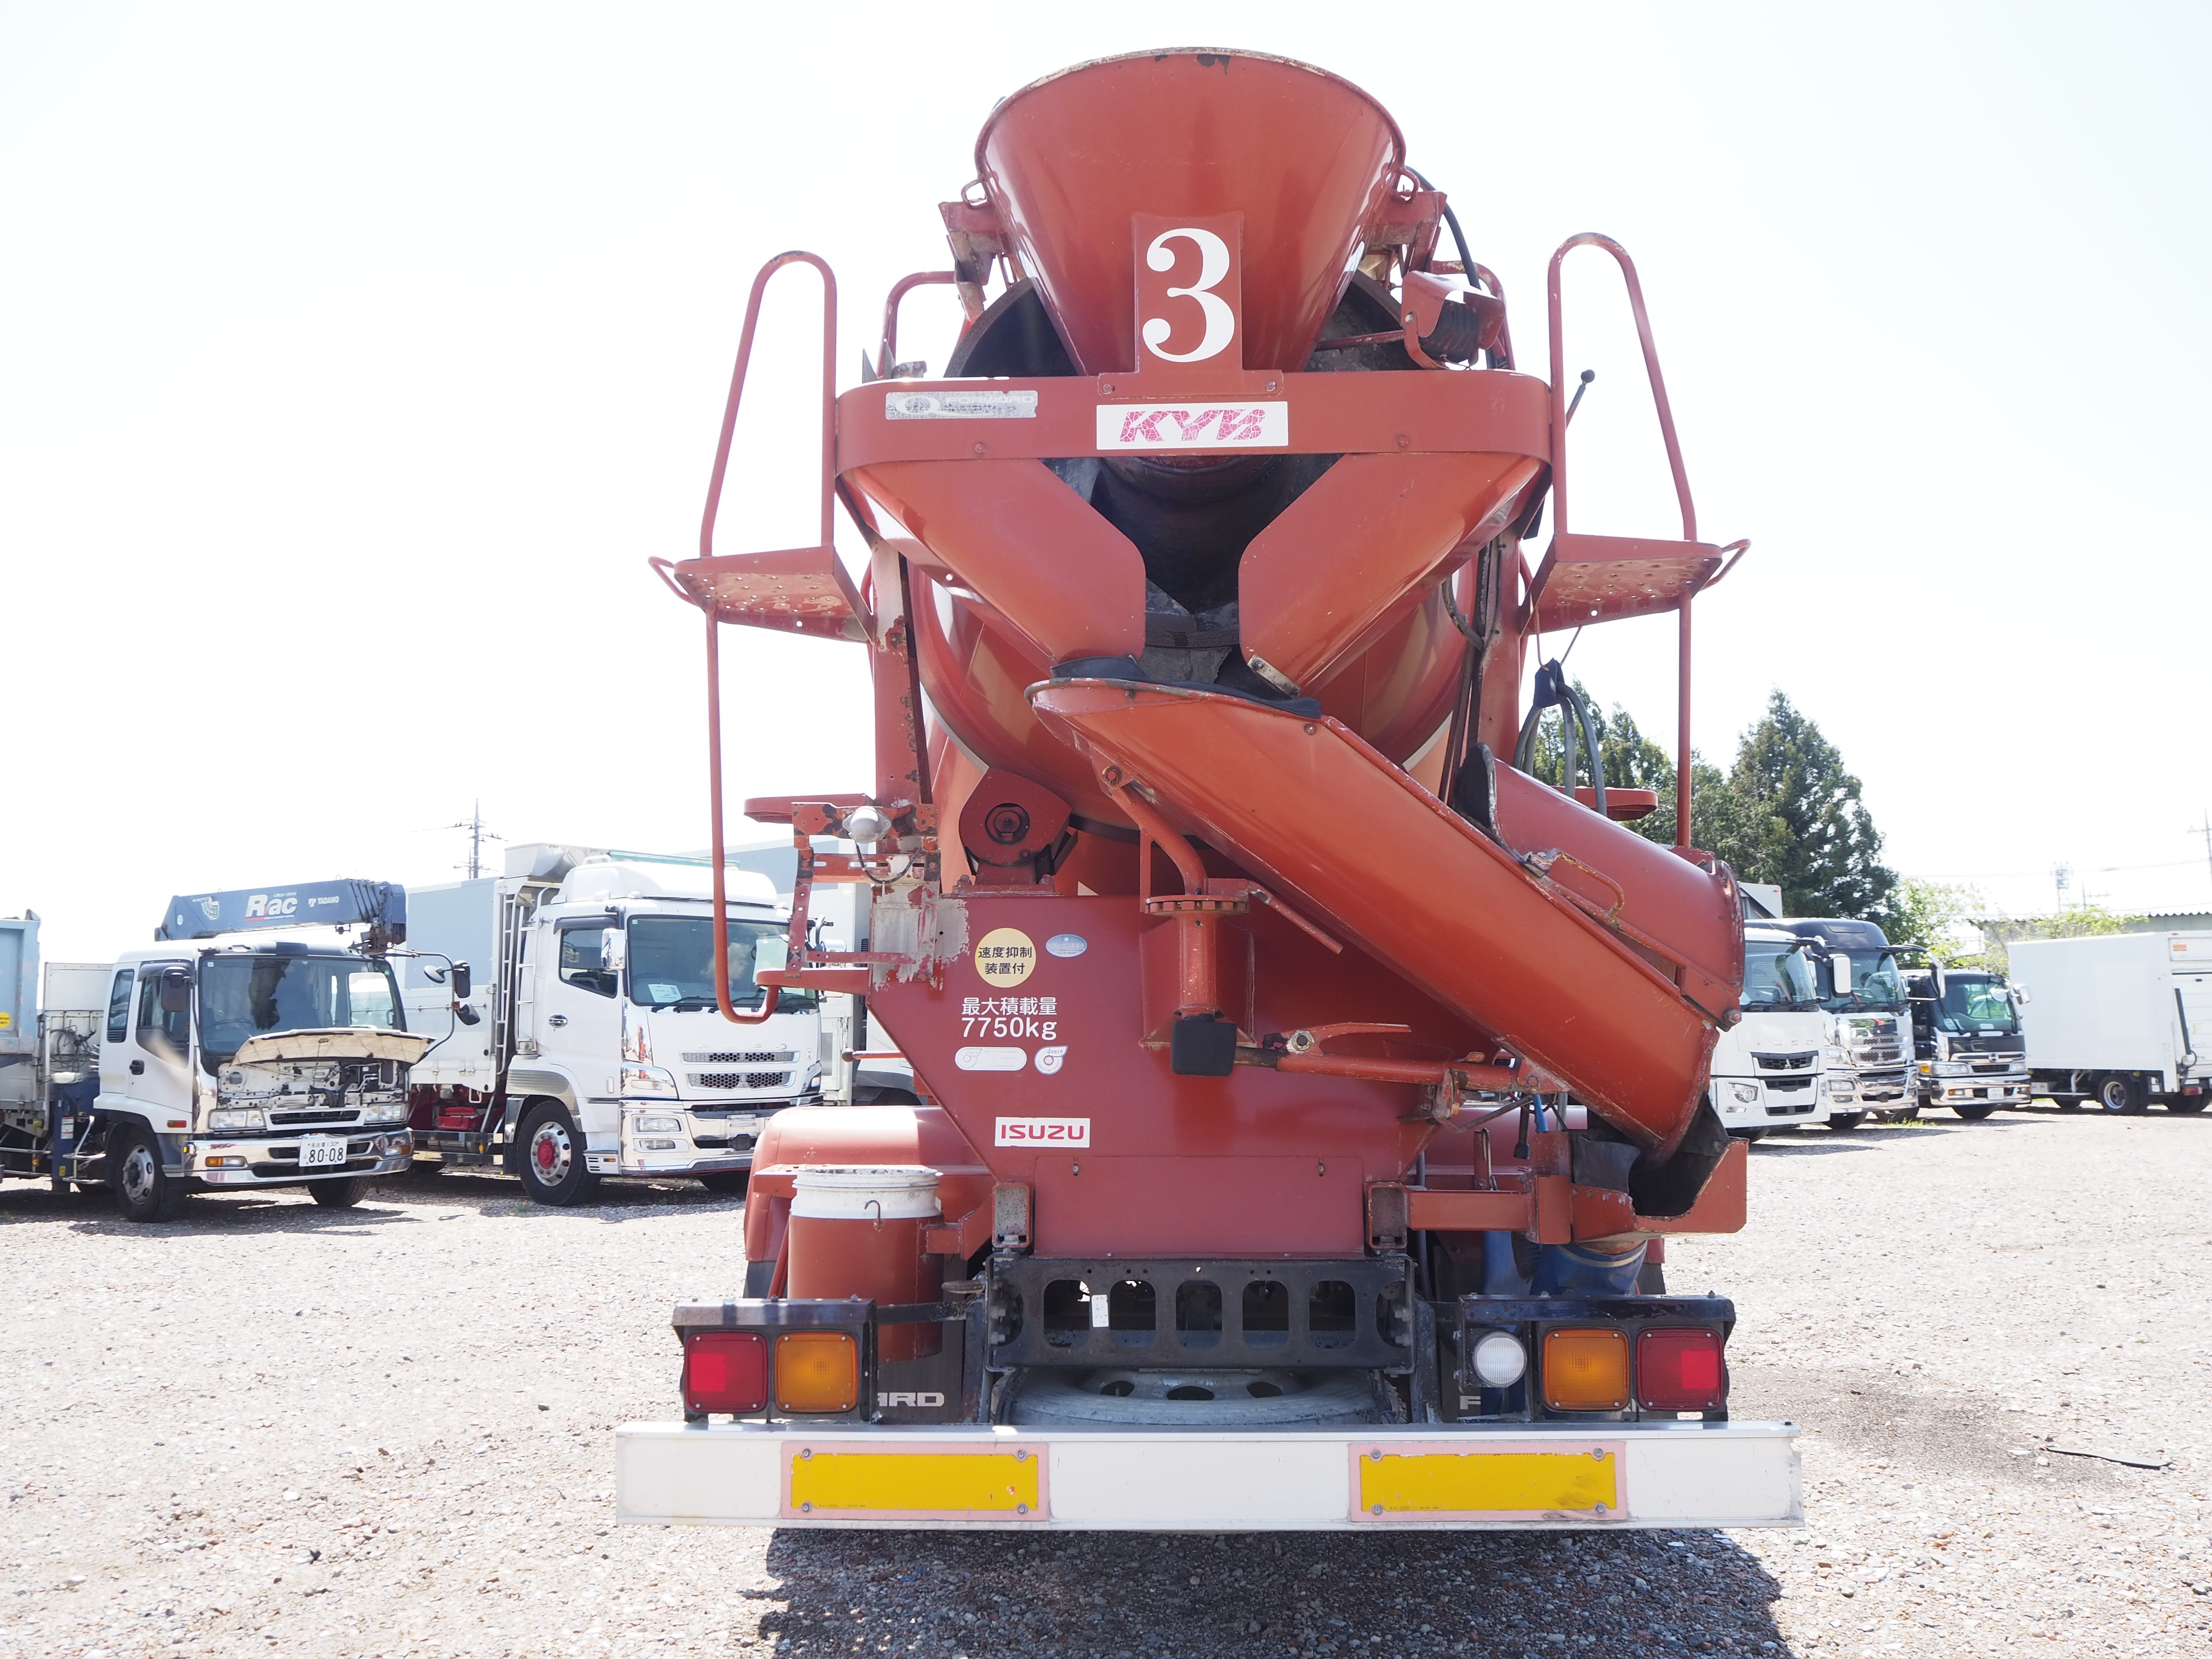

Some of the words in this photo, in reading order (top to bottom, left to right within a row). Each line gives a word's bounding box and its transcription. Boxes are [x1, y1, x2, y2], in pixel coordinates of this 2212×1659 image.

[1142, 228, 1235, 363] 3
[946, 396, 1034, 404] FORWARD
[1119, 409, 1266, 443] KYB
[244, 894, 298, 918] Rac
[317, 896, 340, 905] TADANO
[978, 946, 1033, 958] 速度抑制
[985, 962, 1026, 974] 装置付
[962, 997, 1058, 1016] 最大積載量
[962, 1017, 1058, 1041] 7750kg
[1001, 1124, 1084, 1140] ISUZU
[309, 1147, 344, 1163] 80-08
